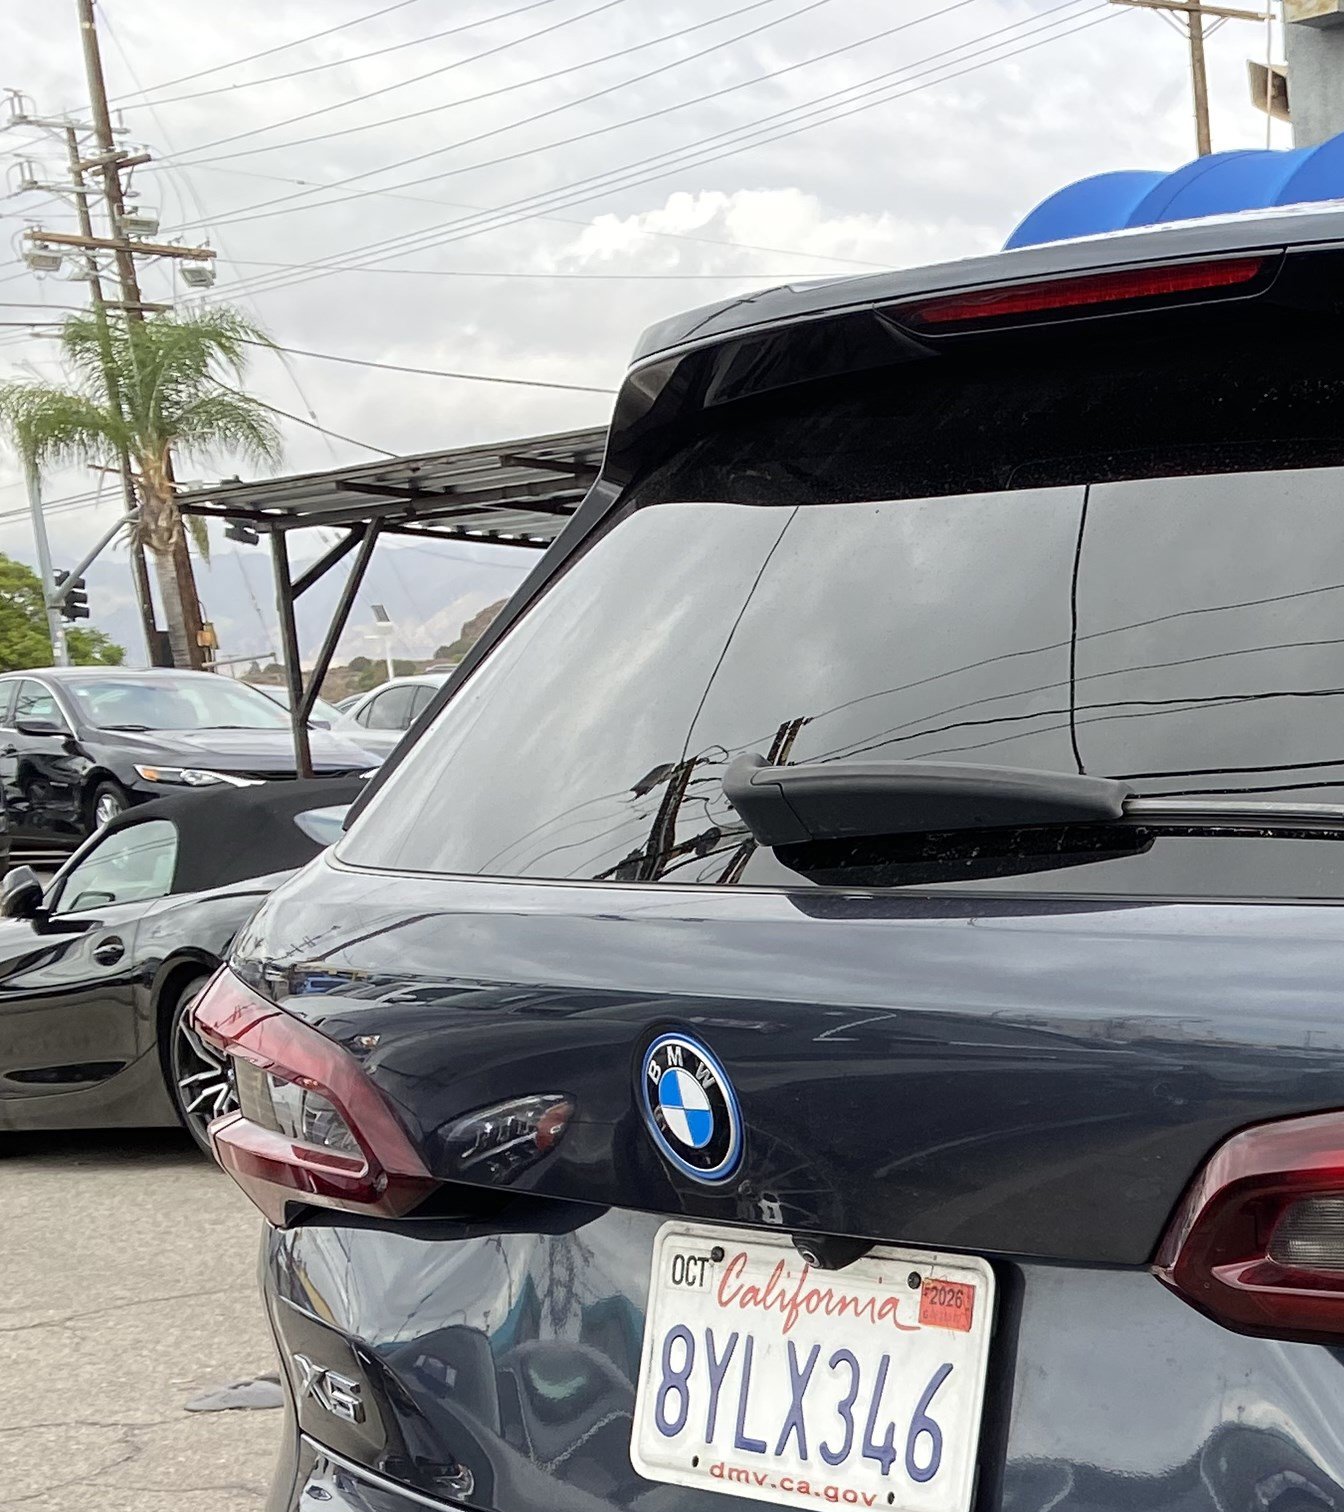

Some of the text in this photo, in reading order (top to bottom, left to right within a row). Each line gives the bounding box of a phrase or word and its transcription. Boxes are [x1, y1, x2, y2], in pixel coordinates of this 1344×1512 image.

[648, 1045, 715, 1089] BMW
[671, 1253, 709, 1288] OCT
[717, 1252, 921, 1334] California
[929, 1285, 963, 1309] 2026
[655, 1324, 954, 1484] 8YLX346
[710, 1461, 877, 1507] dmv.ca.gov
